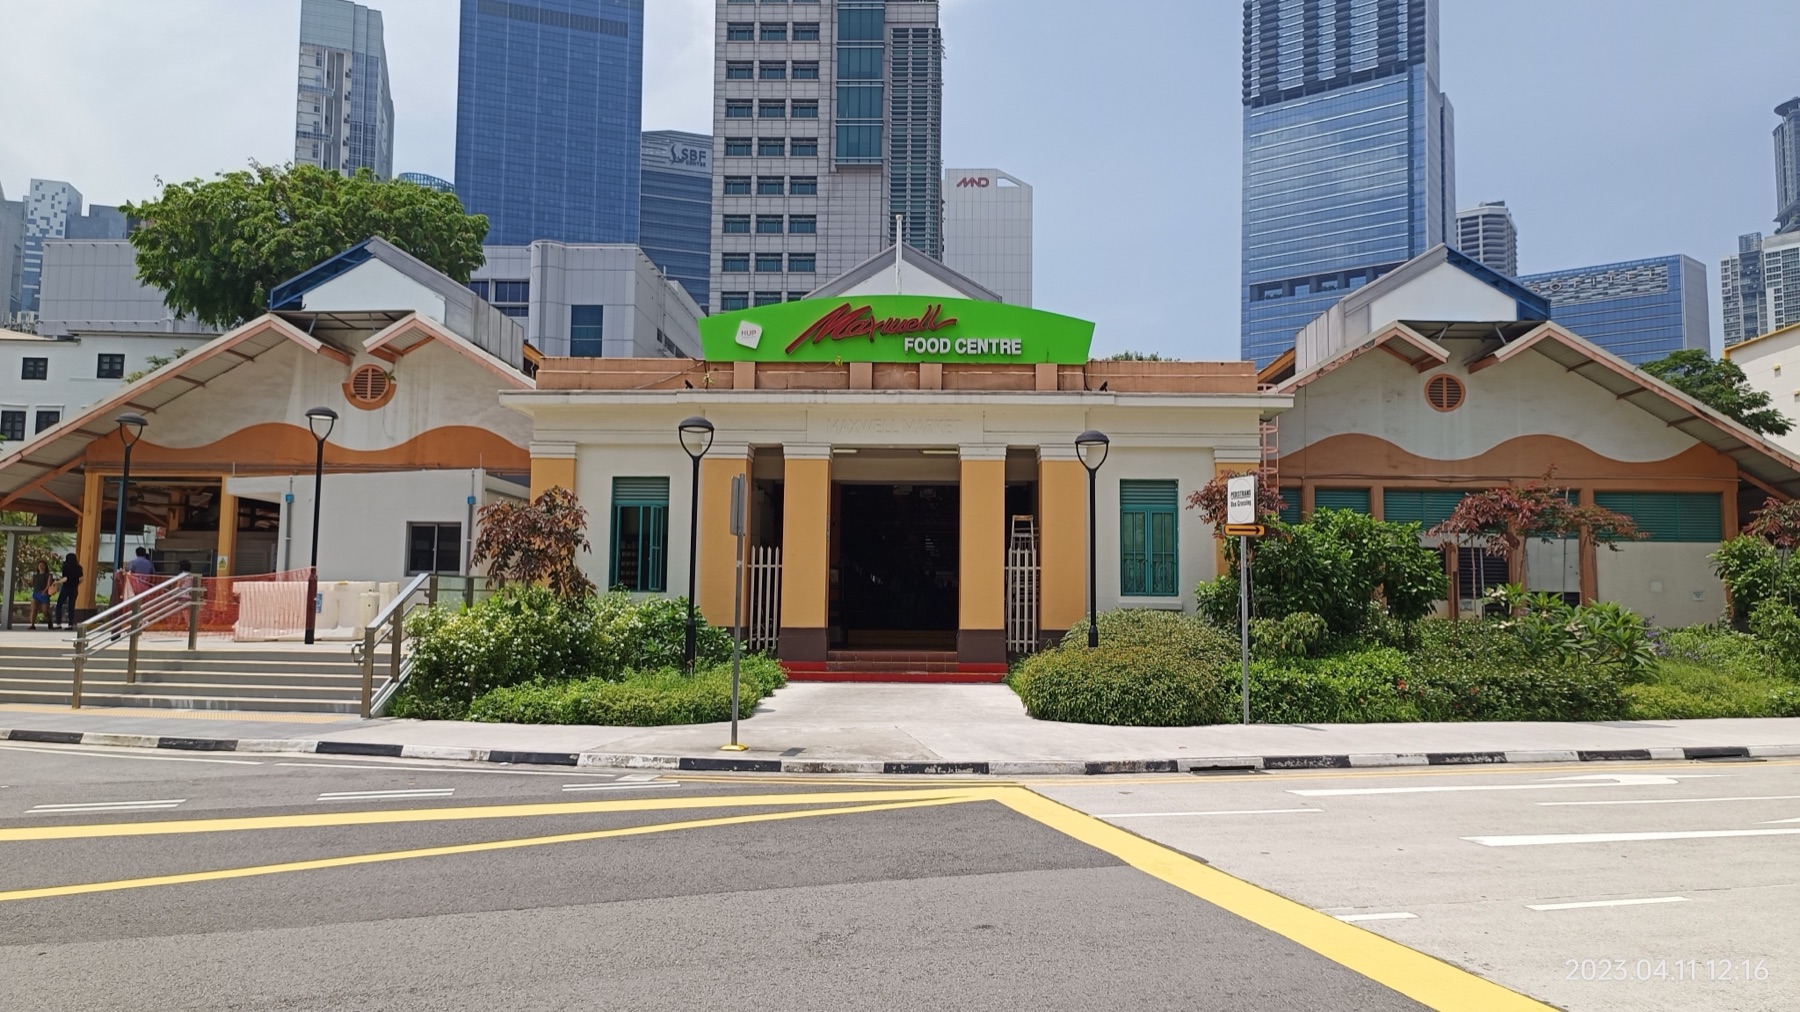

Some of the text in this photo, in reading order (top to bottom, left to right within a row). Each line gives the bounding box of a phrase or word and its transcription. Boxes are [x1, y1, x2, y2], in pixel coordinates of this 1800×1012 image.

[681, 148, 706, 161] SBF
[784, 302, 957, 354] Maxwell
[904, 337, 1022, 355] FOOD CENTRE
[826, 418, 962, 434] MAXWELL MARKET
